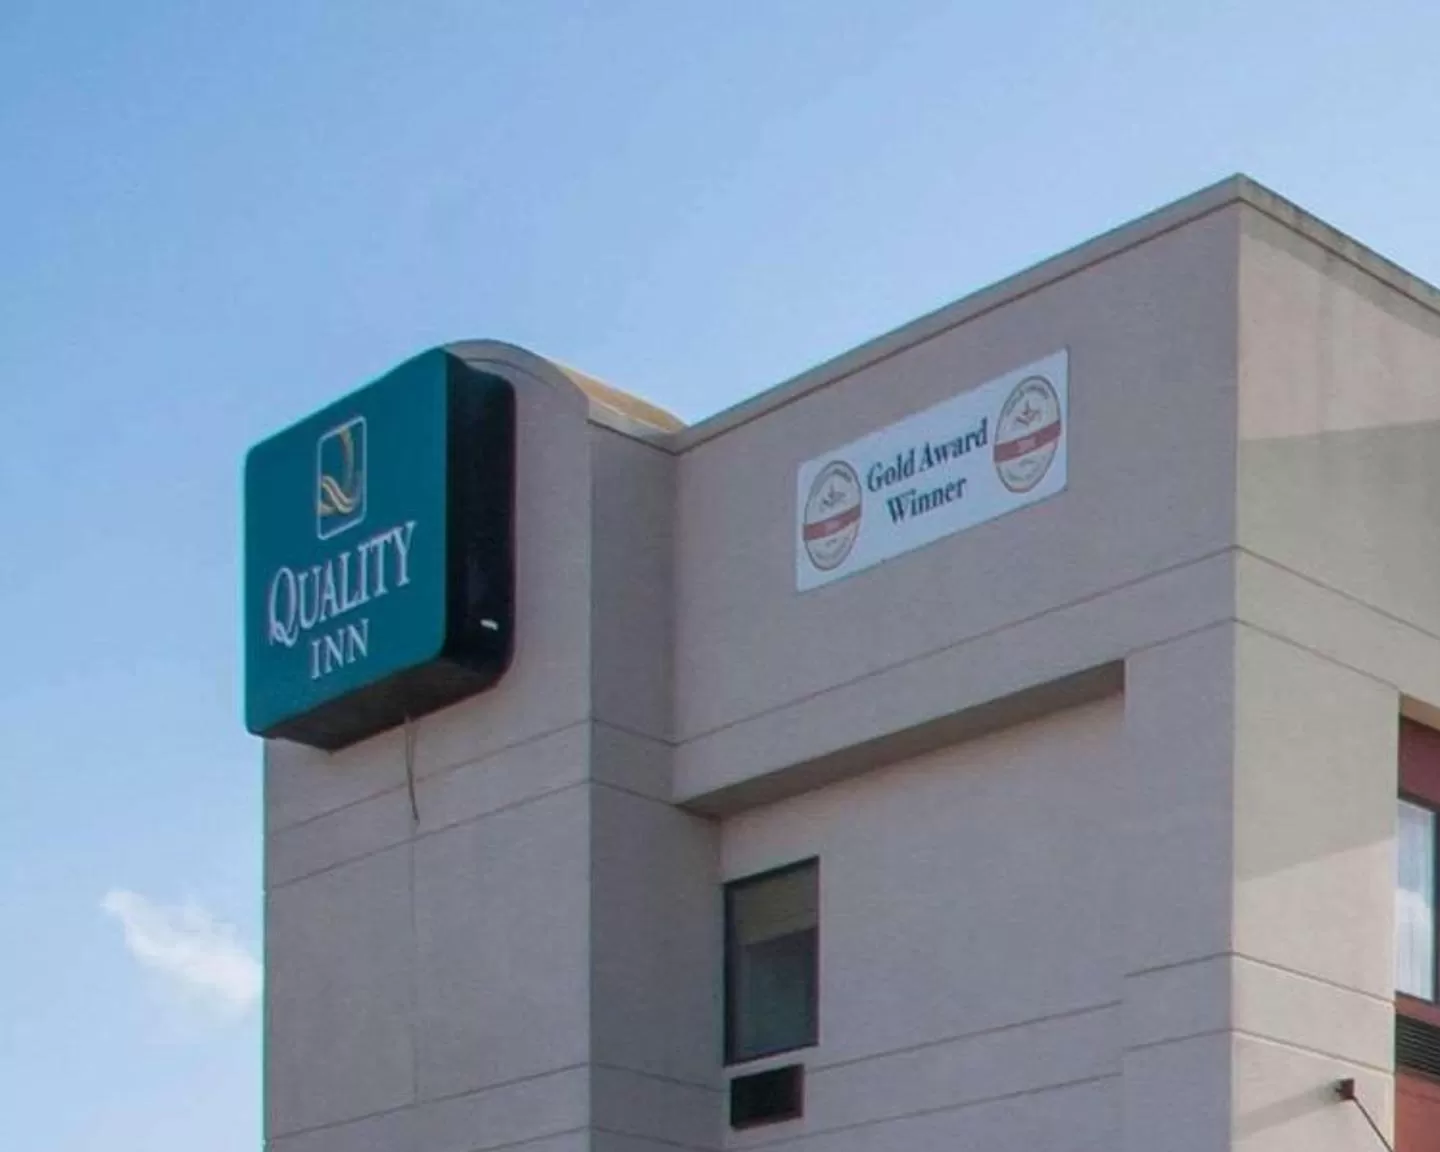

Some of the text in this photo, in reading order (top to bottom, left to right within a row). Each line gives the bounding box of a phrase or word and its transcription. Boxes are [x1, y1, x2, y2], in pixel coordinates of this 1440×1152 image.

[867, 447, 916, 492] Gold
[918, 417, 988, 473] Award
[886, 477, 967, 524] Winner
[268, 520, 417, 648] QUALITY
[310, 618, 370, 680] INN
